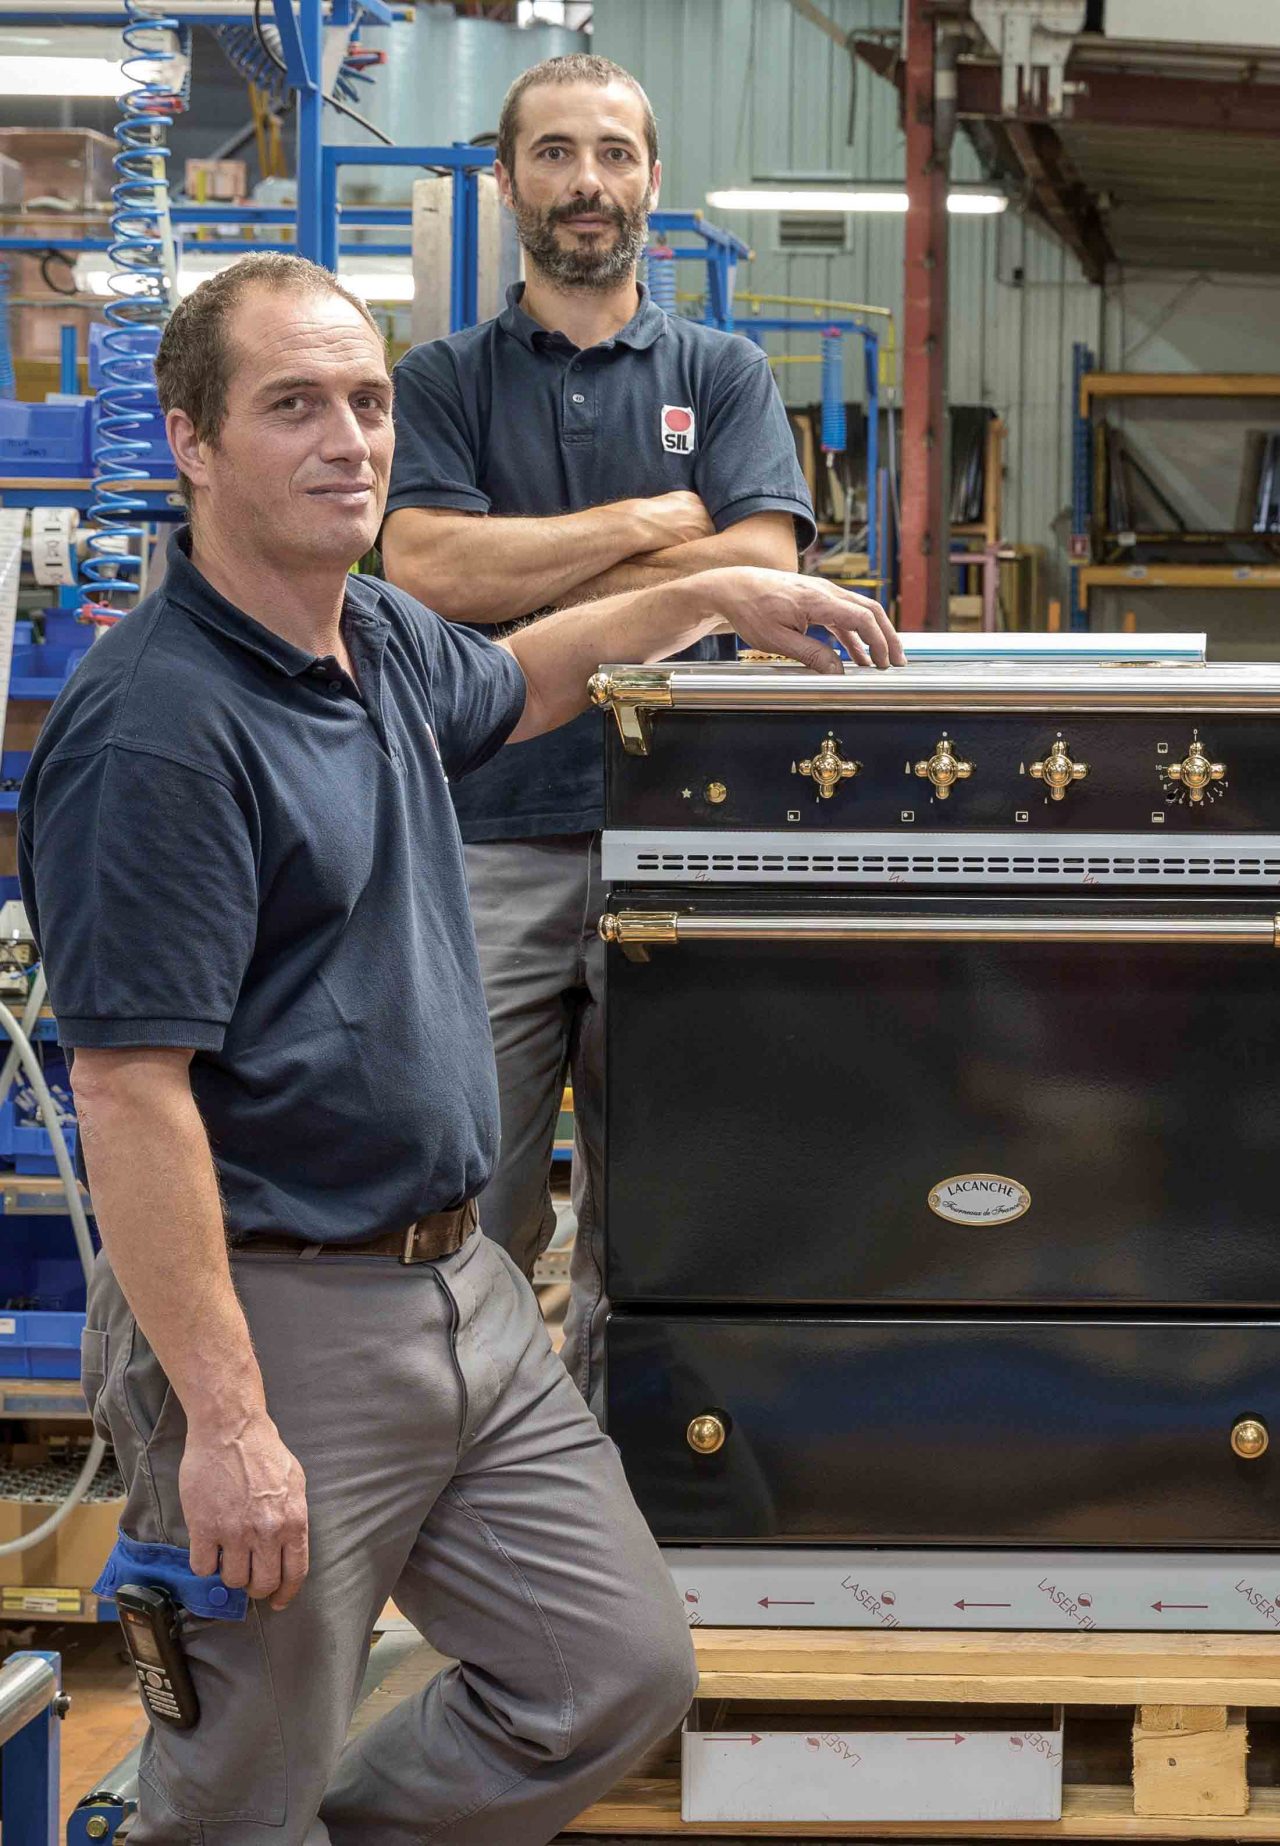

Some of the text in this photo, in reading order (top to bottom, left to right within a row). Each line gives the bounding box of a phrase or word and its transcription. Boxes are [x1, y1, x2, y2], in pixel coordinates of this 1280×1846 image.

[665, 434, 689, 451] SIL
[947, 1181, 1014, 1197] LACANCHE
[983, 1208, 990, 1216] de
[991, 1203, 1020, 1215] France
